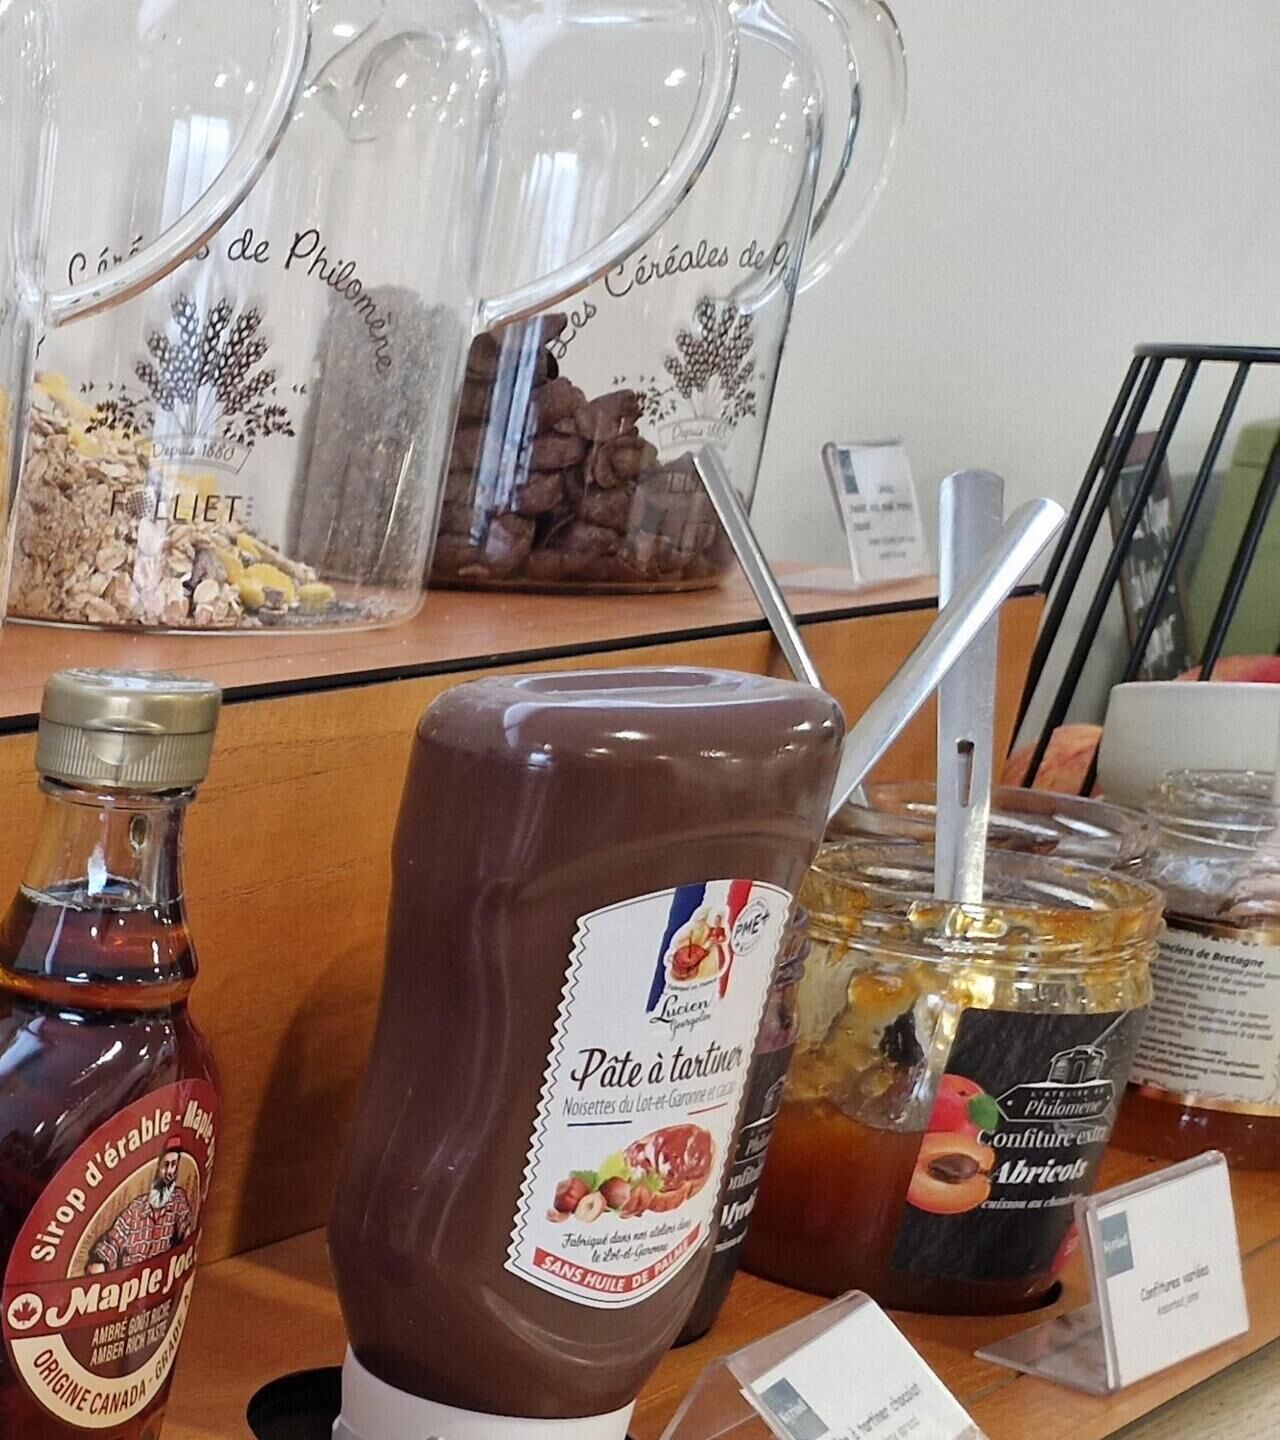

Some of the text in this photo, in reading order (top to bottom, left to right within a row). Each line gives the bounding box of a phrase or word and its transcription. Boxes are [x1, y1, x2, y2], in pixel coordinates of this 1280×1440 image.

[227, 227, 270, 263] de
[284, 228, 392, 374] Philomène
[544, 300, 597, 360] Les
[604, 239, 729, 297] Céréales
[739, 239, 764, 270] de
[1212, 951, 1265, 968] Bretagne
[649, 994, 710, 1024] Lucien
[570, 1040, 744, 1092] Pâte à tartiner
[562, 1096, 616, 1116] Noisettes
[618, 1094, 633, 1114] du
[635, 1086, 706, 1113] Lot-et-Garonne
[976, 1127, 1075, 1149] Confiture
[30, 1187, 87, 1262] Sirop
[84, 1108, 173, 1188] d'érable
[182, 1100, 214, 1144] Maple
[991, 1158, 1089, 1185] Abricots
[561, 1232, 608, 1249] Fabriqué
[609, 1231, 632, 1245] dans
[541, 1255, 583, 1285] SANS
[583, 1272, 625, 1292] HUILE
[631, 1270, 650, 1288] DE
[654, 1238, 690, 1275] PALME
[45, 1267, 163, 1328] Maple
[90, 1321, 168, 1367] AMBER RICH TASTE
[91, 1315, 128, 1347] AMBRÉ
[127, 1308, 151, 1336] GOÛT
[33, 1349, 92, 1412] ORIGINE
[90, 1377, 147, 1415] CANADA
